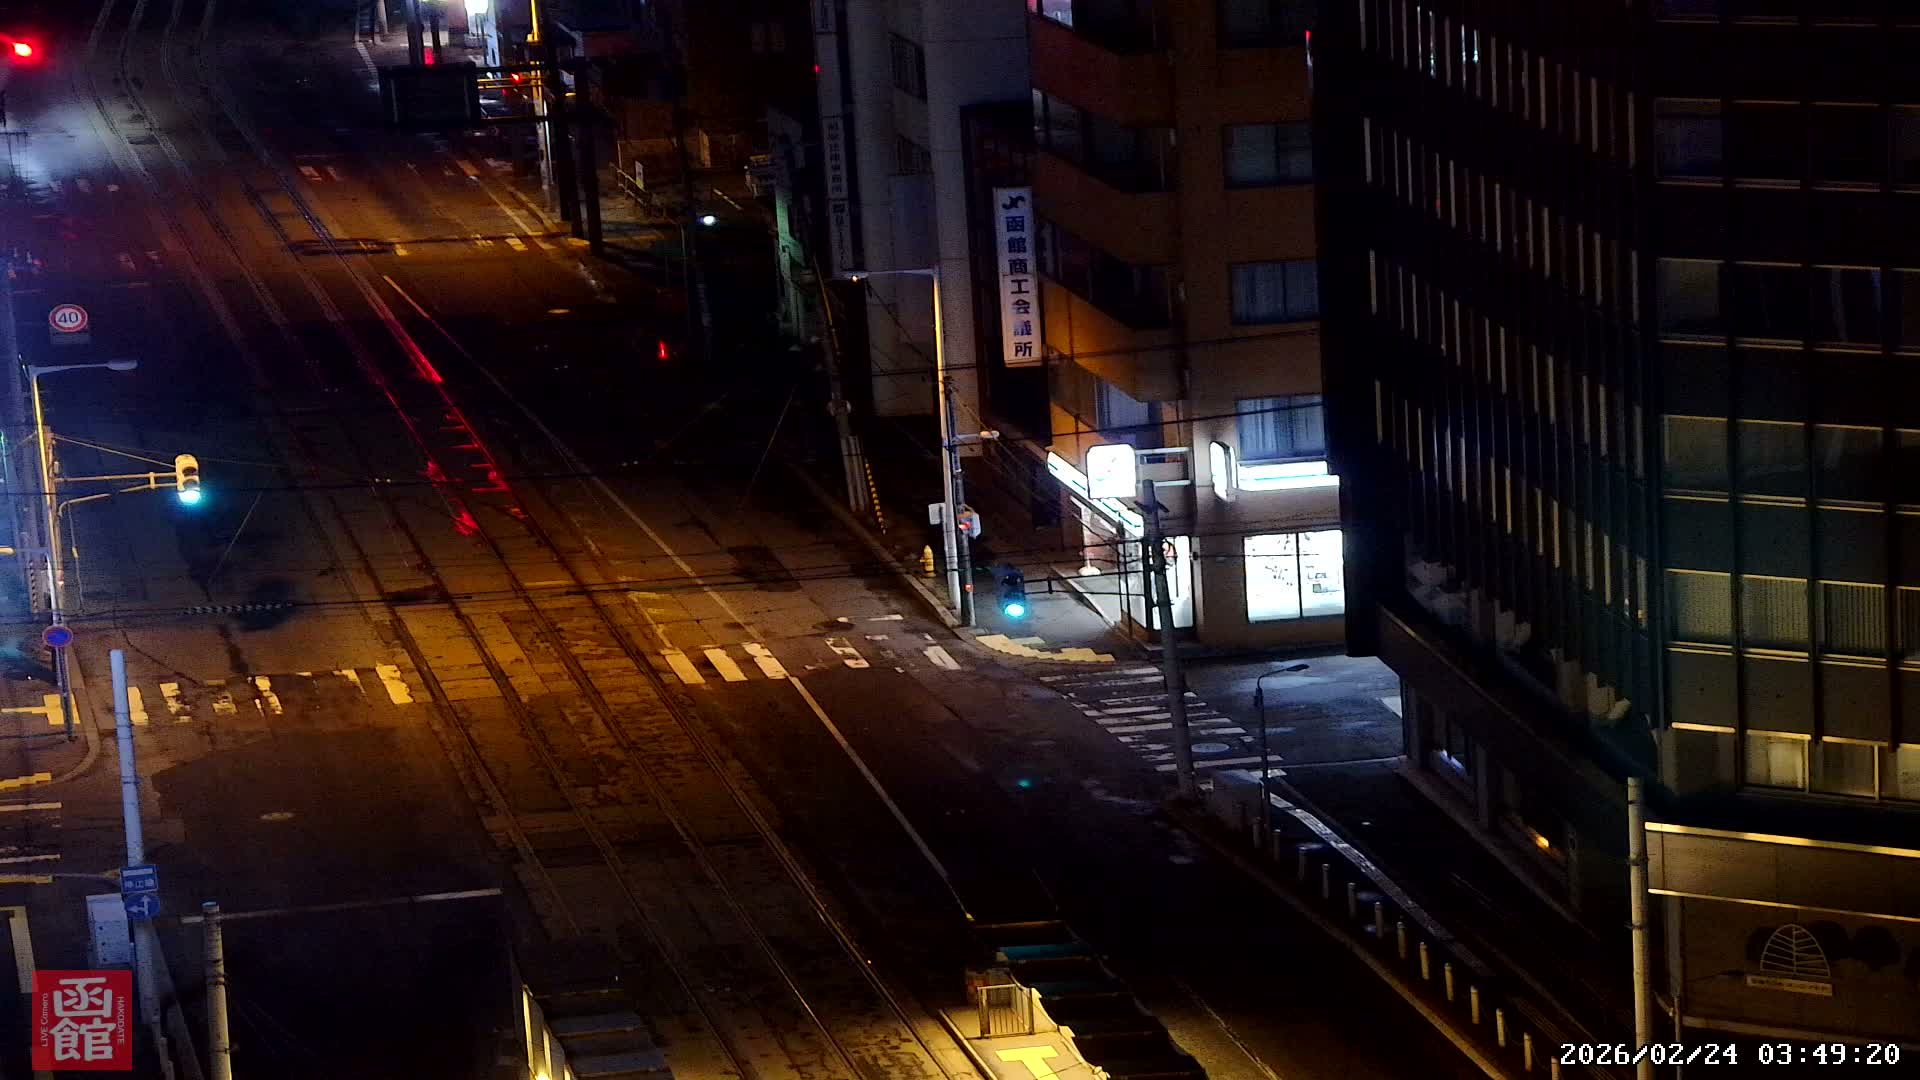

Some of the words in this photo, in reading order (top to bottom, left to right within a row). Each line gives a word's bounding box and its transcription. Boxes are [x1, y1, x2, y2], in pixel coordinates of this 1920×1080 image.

[58, 311, 78, 323] 40
[1006, 215, 1032, 357] 函館商工会議所
